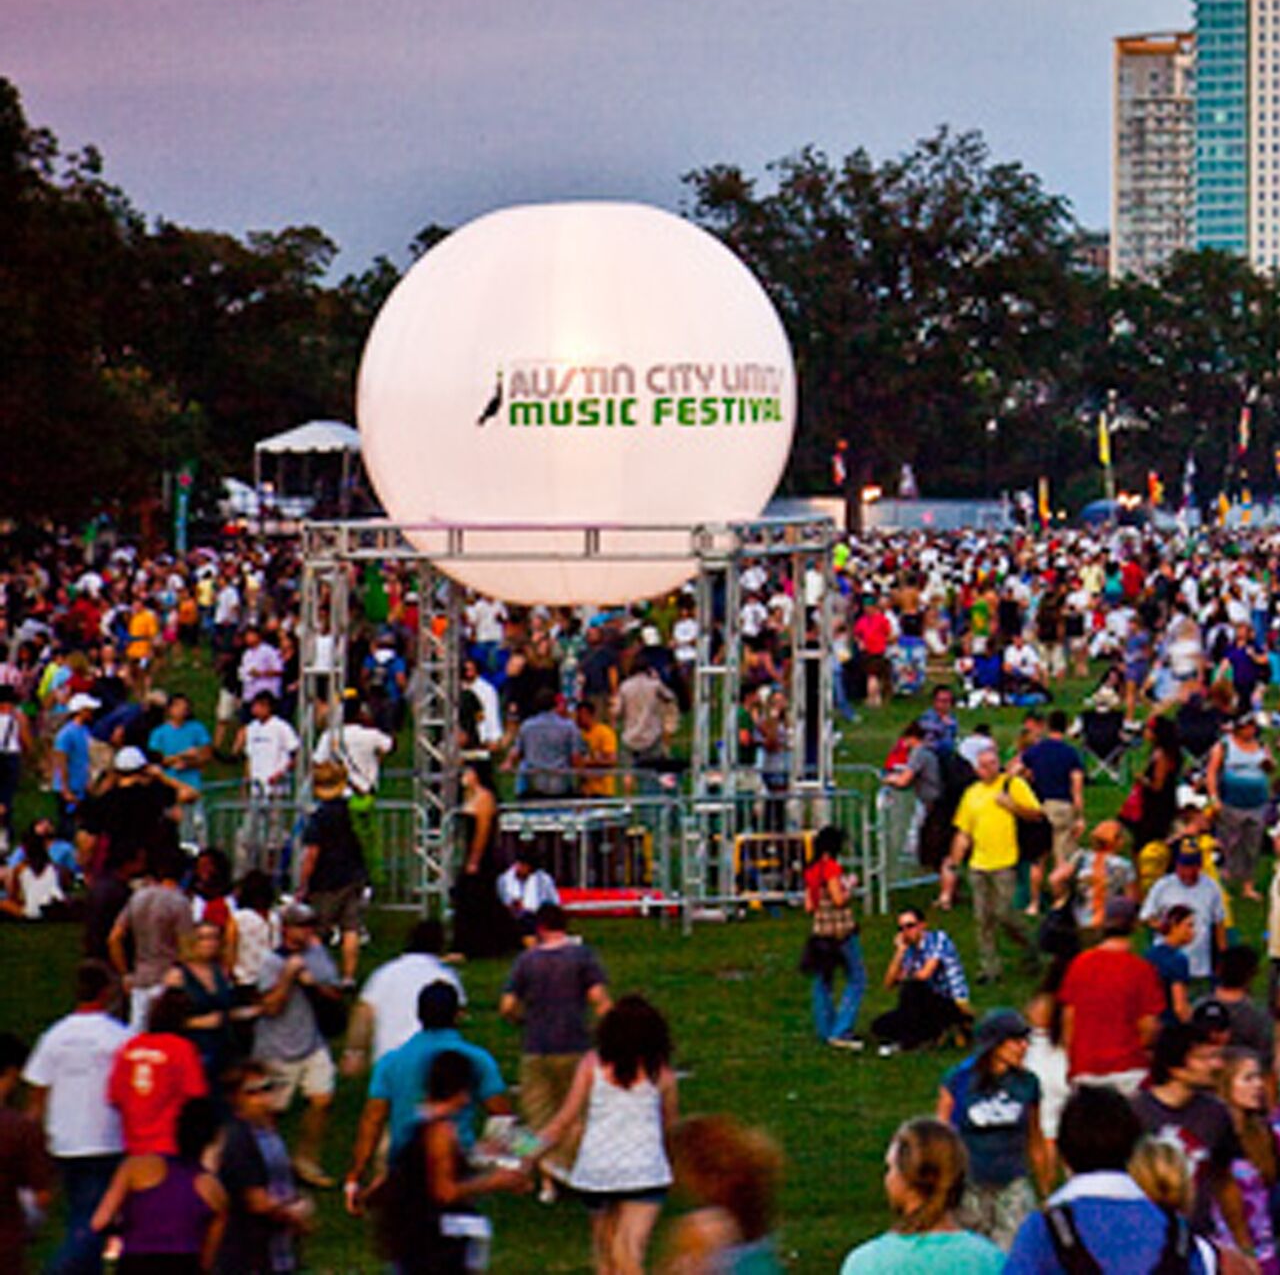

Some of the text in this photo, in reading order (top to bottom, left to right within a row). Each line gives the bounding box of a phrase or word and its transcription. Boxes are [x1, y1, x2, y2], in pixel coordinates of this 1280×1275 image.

[509, 365, 636, 399] AUSTIN
[645, 363, 714, 395] CITY
[508, 397, 783, 426] MUSIC FESTIVAL
